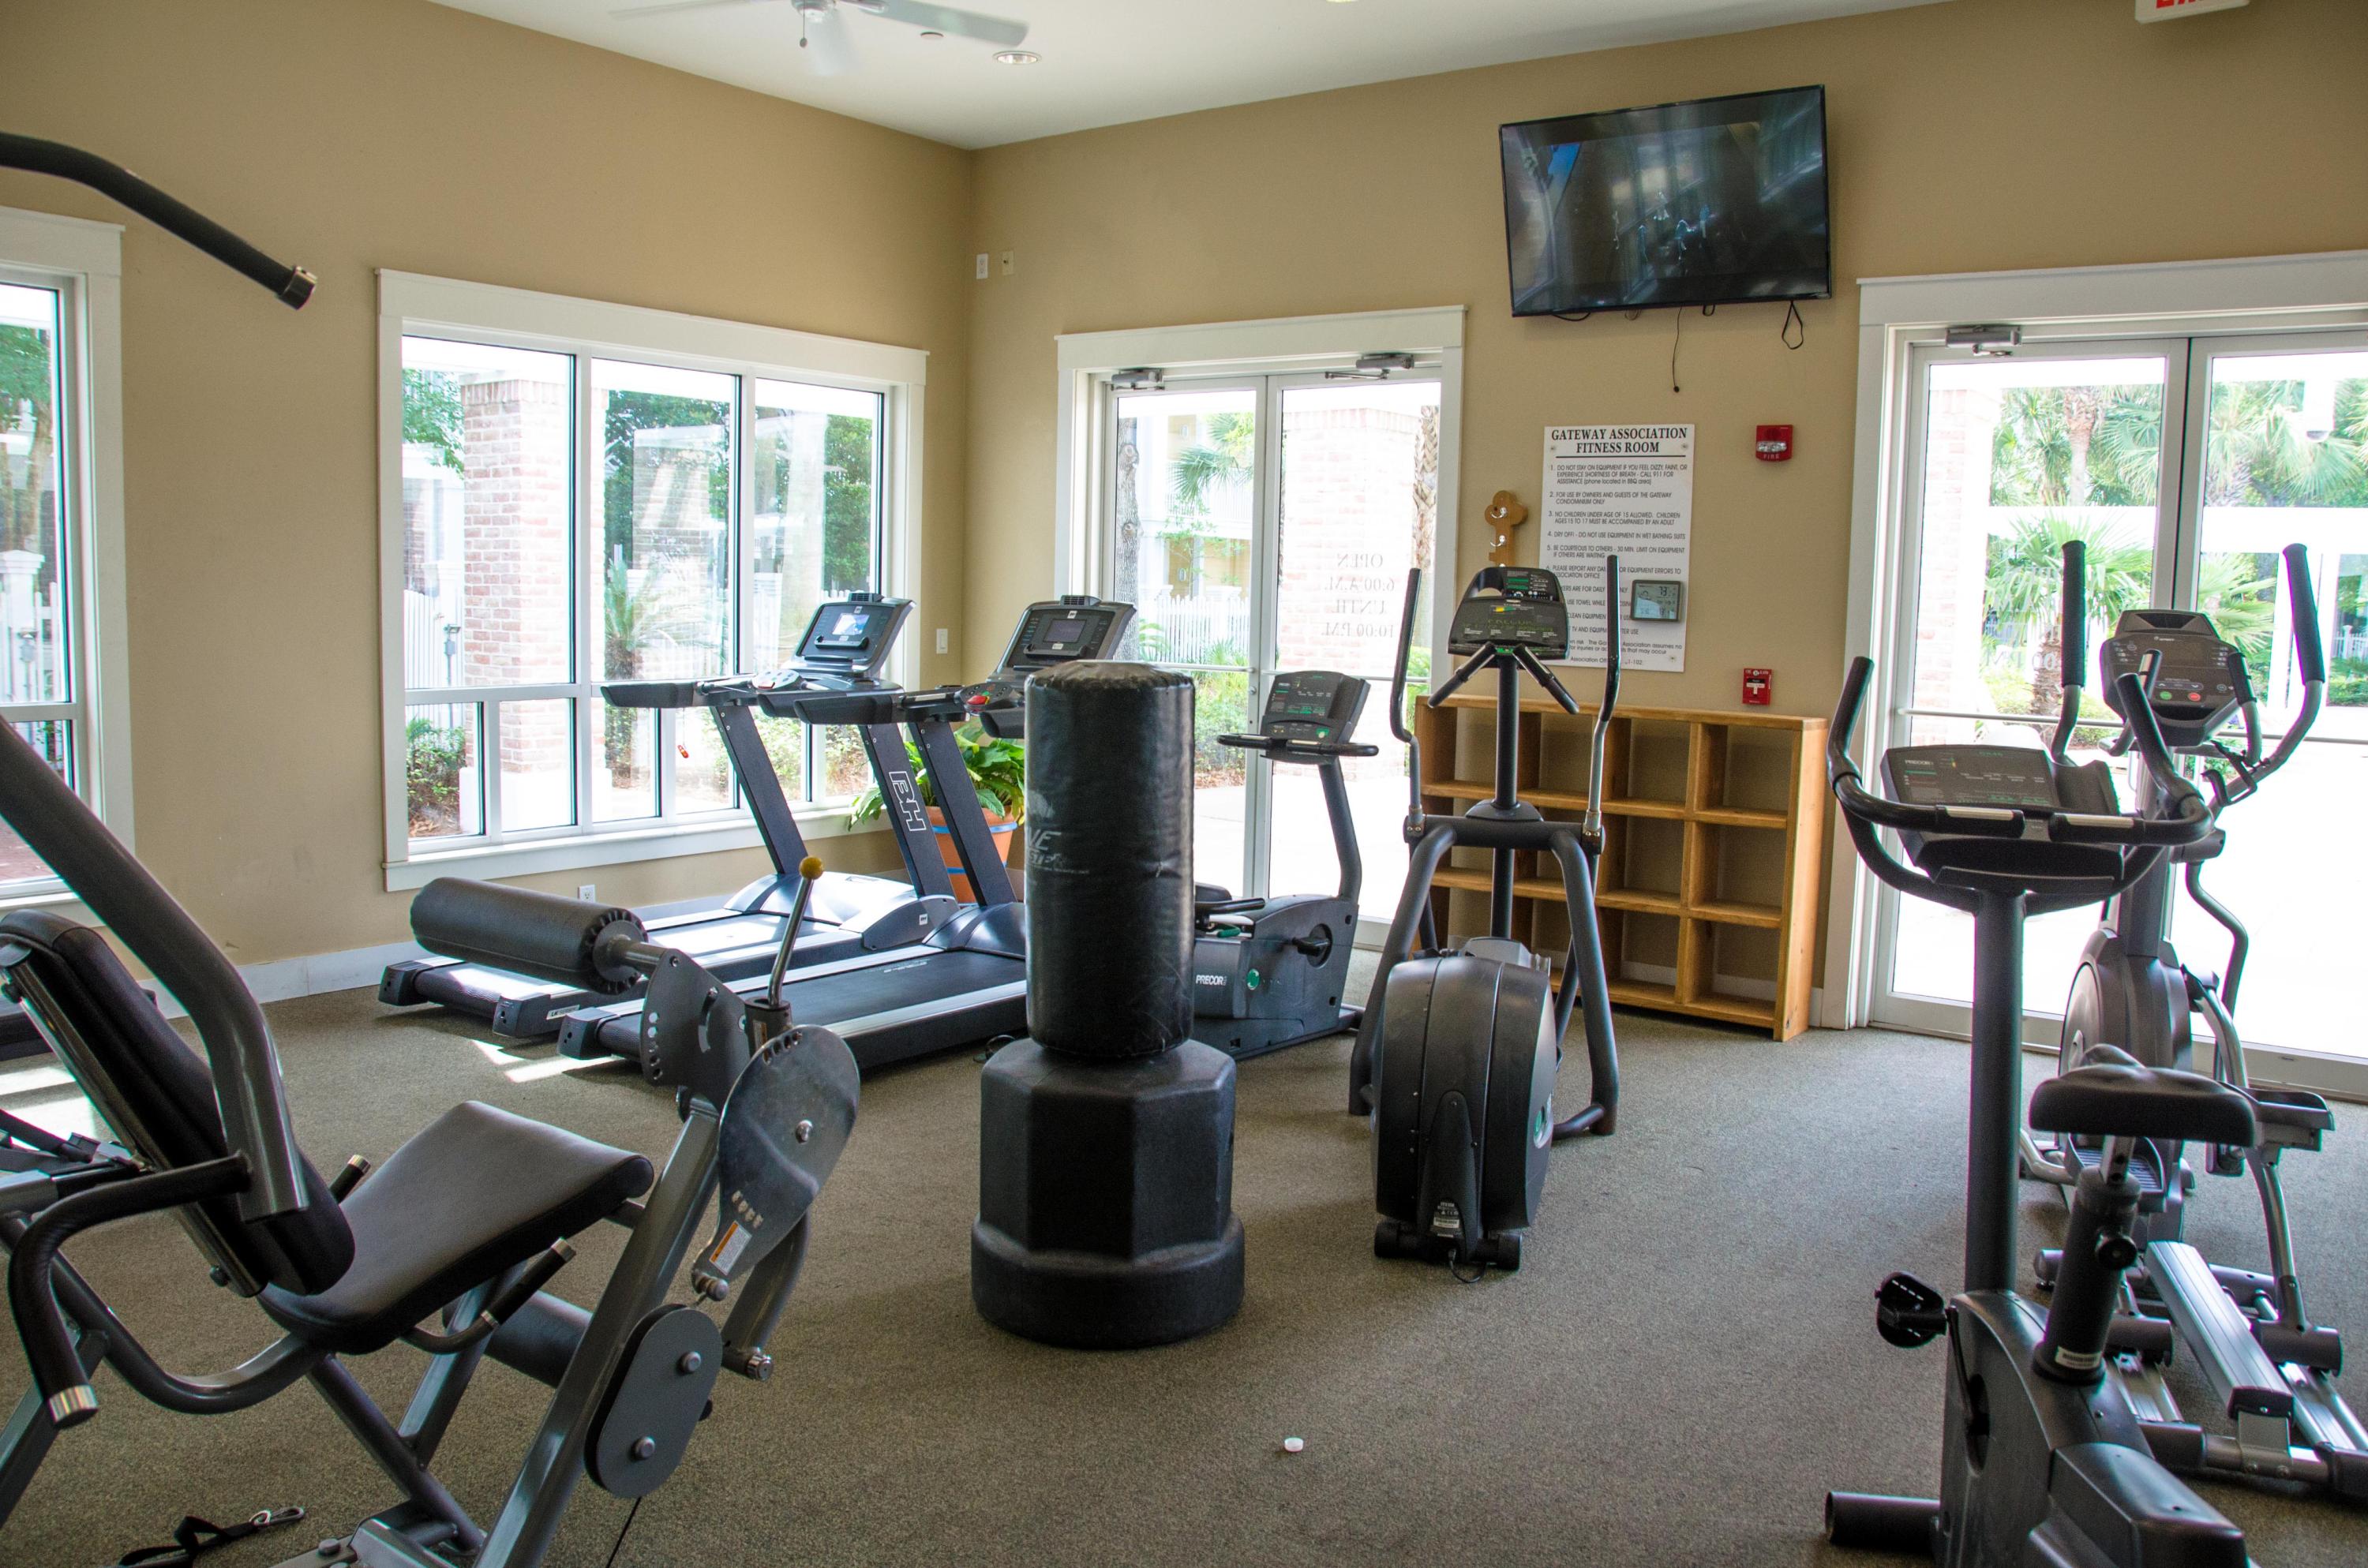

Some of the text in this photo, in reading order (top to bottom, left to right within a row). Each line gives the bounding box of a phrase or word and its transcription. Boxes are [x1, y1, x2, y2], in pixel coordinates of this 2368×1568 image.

[1552, 428, 1687, 440] GATEWAY ASSOCIATION
[1576, 442, 1659, 453] FITNESS ROOM
[888, 770, 927, 832] BH
[1195, 975, 1223, 986] PRECOR
